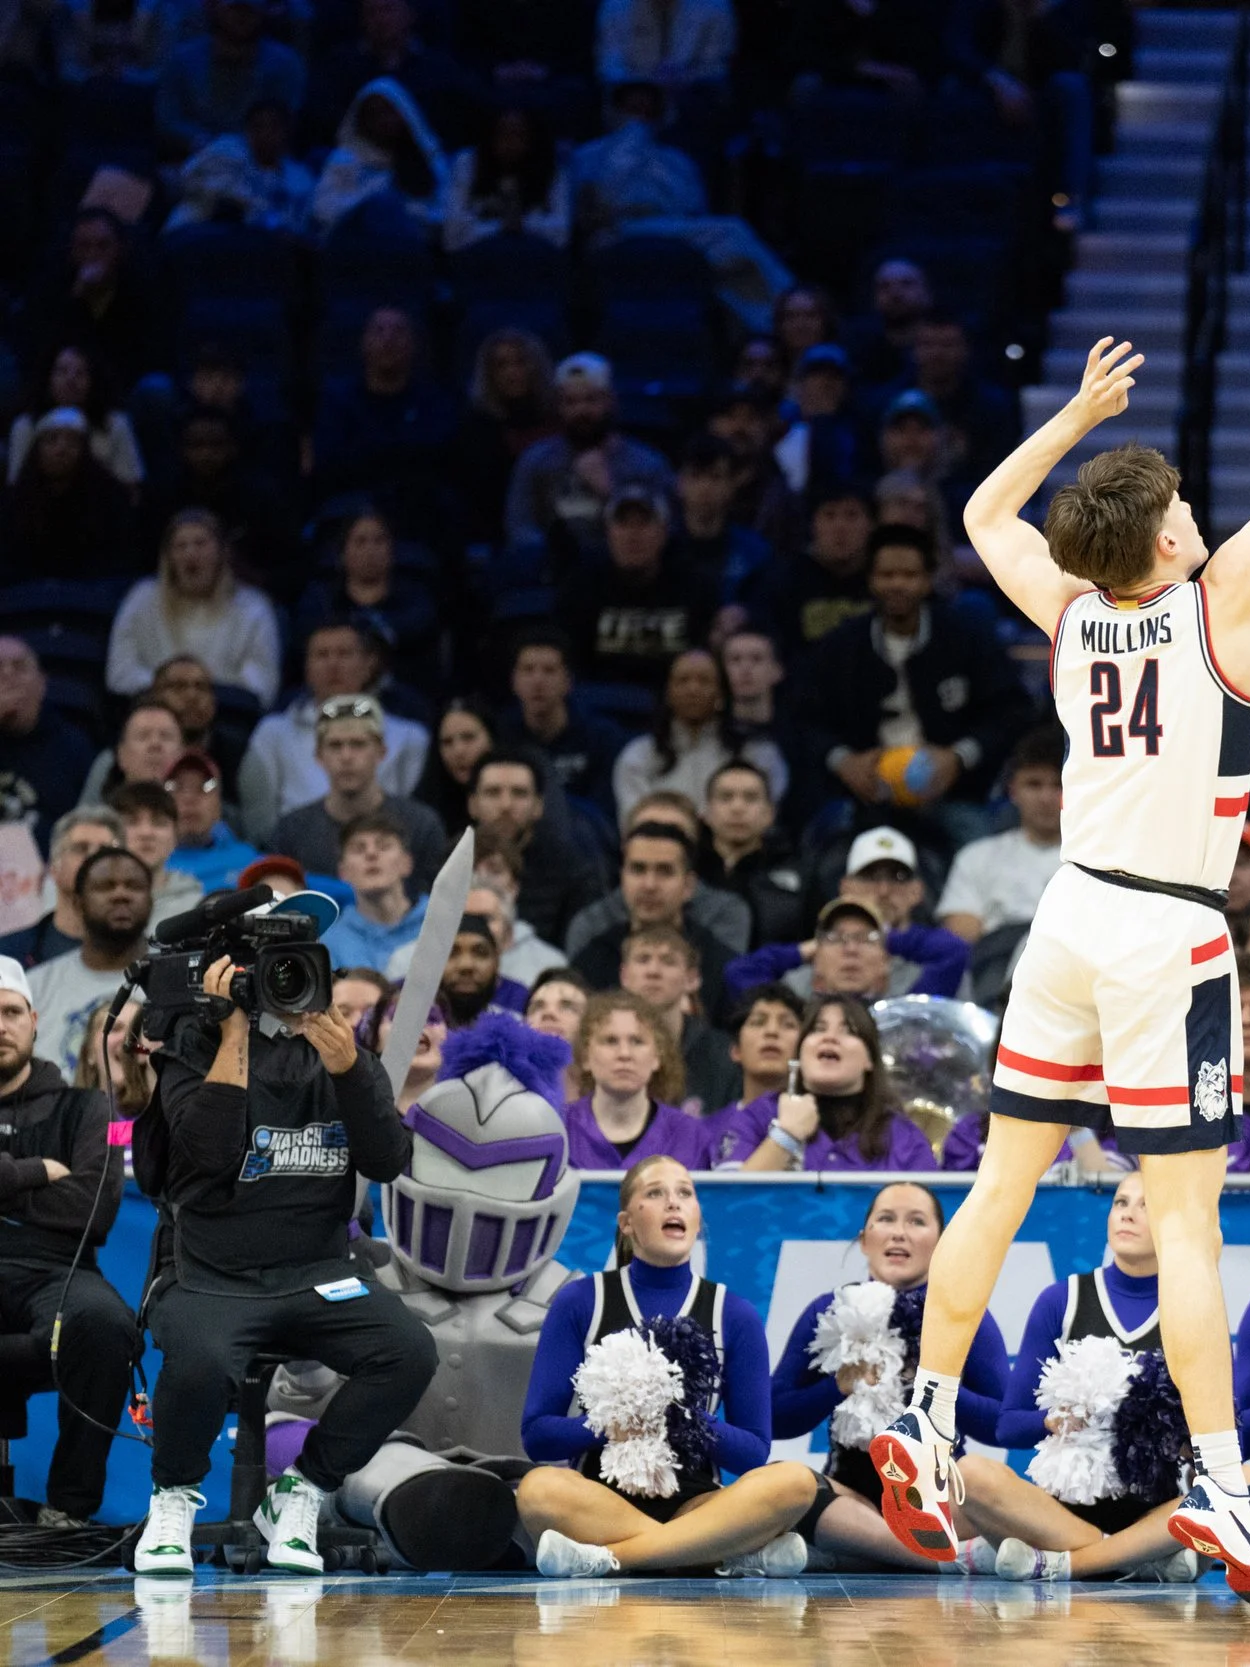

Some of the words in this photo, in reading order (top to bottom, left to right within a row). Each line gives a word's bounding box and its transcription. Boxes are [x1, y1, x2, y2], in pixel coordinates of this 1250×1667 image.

[1081, 612, 1172, 654] MULLINS
[1090, 658, 1163, 758] 24
[273, 1146, 350, 1167] MADNESS
